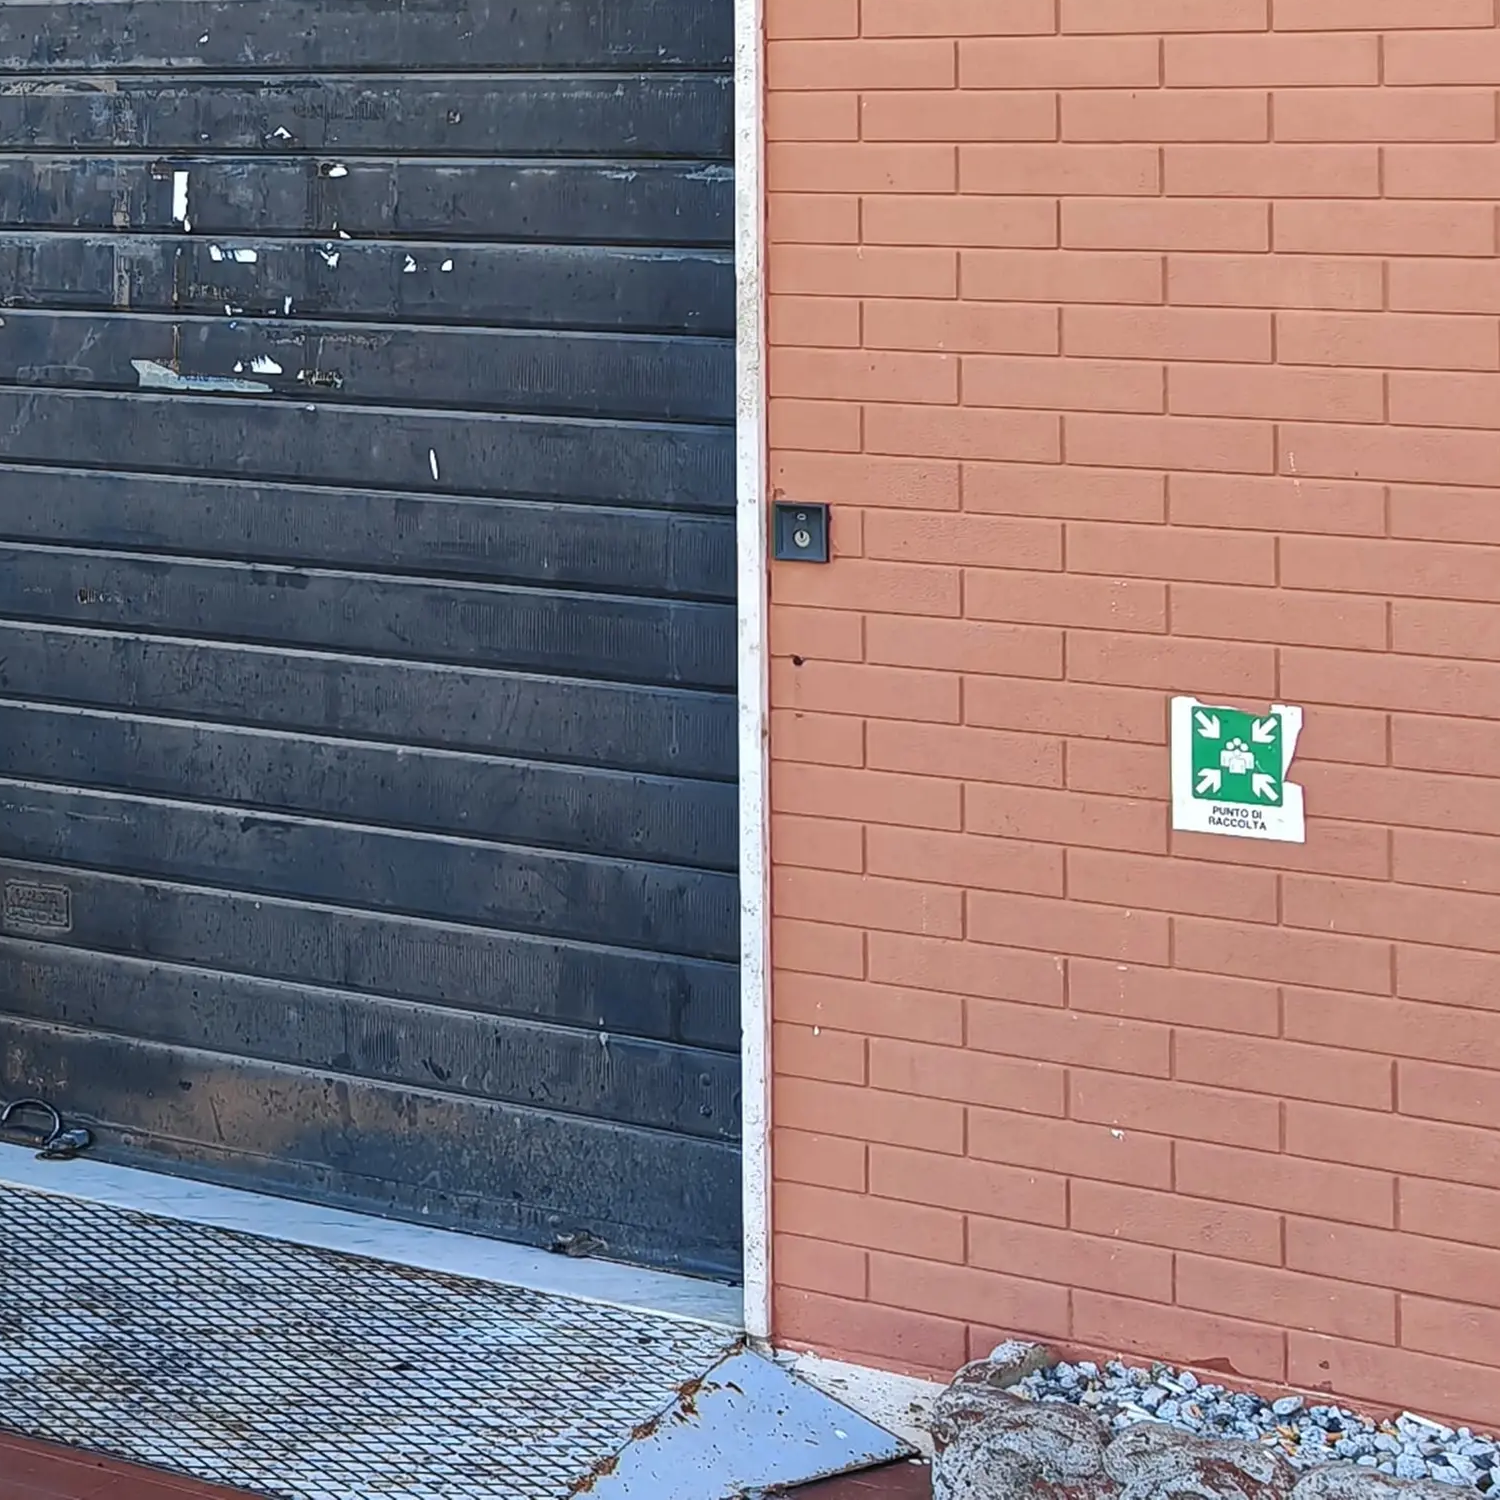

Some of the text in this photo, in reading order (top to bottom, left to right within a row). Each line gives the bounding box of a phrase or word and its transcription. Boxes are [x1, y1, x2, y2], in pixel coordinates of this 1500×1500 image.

[1212, 806, 1262, 820] PUNTO DI
[1208, 816, 1266, 830] RACCOLTA
